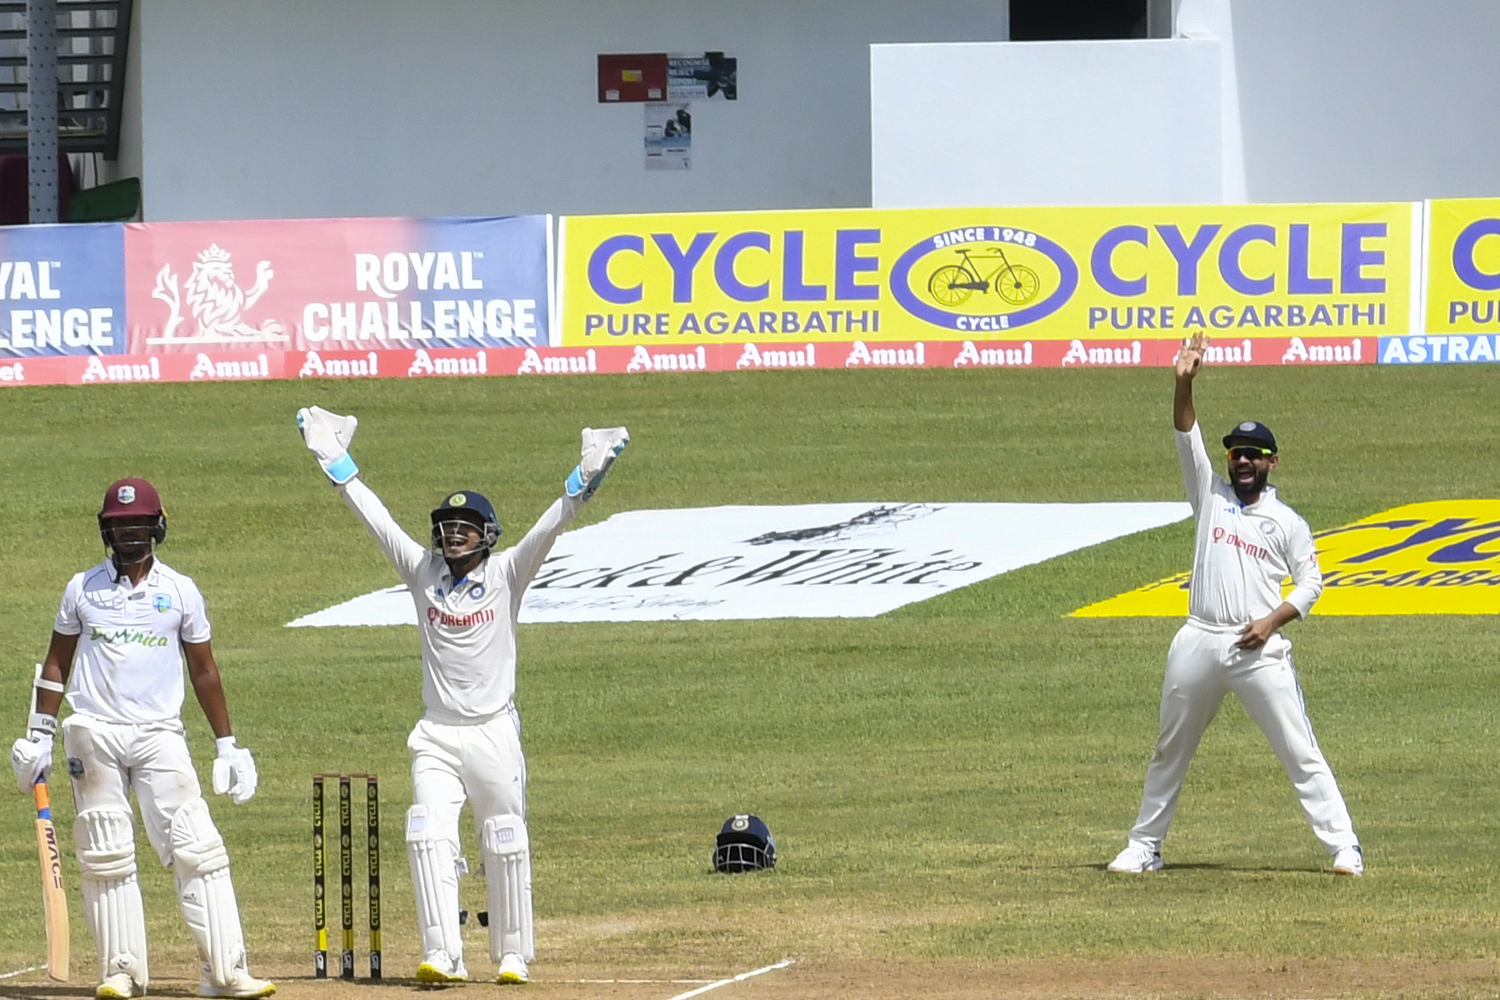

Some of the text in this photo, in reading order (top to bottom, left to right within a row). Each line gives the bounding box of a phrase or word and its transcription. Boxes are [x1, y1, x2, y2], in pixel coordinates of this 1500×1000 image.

[933, 227, 1037, 249] SINCE 1948
[587, 228, 881, 304] CYCLE
[1091, 222, 1387, 297] CYCLE
[355, 251, 483, 298] ROYAL
[303, 299, 537, 343] CHALLENGE
[585, 310, 881, 337] PURE AGARBATHI
[956, 315, 1009, 331] CYCLE
[1088, 303, 1387, 329] PURE AGARBATHI
[1449, 301, 1500, 324] PU
[299, 350, 378, 378] Amul
[408, 348, 488, 377] Amul
[517, 347, 597, 375] Amul
[627, 345, 707, 373] Amul
[736, 342, 816, 370] Amul
[845, 340, 925, 369] Amul
[954, 340, 1033, 368] Amul
[1061, 339, 1141, 366] Amul
[1173, 339, 1253, 366] mul
[1282, 337, 1363, 365] Amul
[82, 356, 161, 384] Amul
[190, 353, 269, 381] Amul
[440, 608, 494, 627] DREAM11
